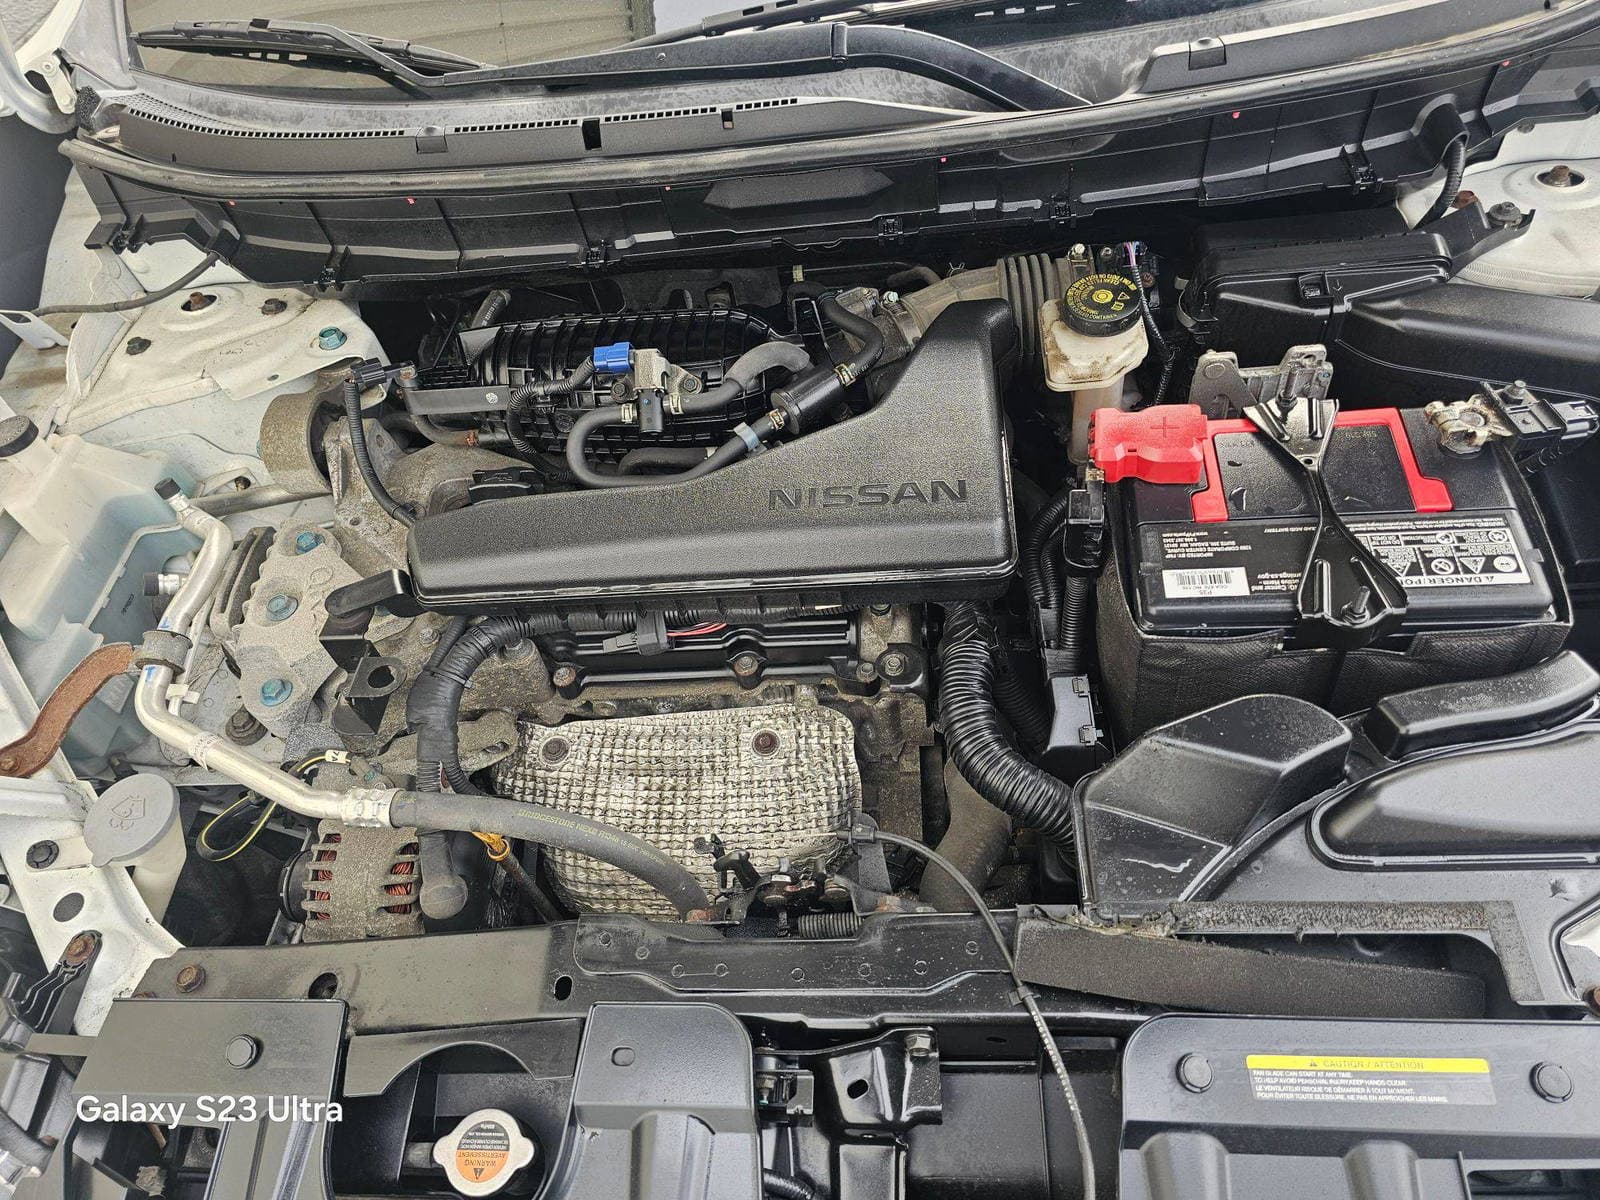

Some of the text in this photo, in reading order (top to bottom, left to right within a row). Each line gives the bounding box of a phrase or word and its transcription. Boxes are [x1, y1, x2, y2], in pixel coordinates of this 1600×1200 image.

[769, 479, 968, 510] NISSAN
[518, 808, 575, 828] BRIDGESTONE
[1323, 1060, 1364, 1068] CAUTION
[1374, 1061, 1424, 1069] ATTENTION
[464, 1158, 497, 1167] WARNING
